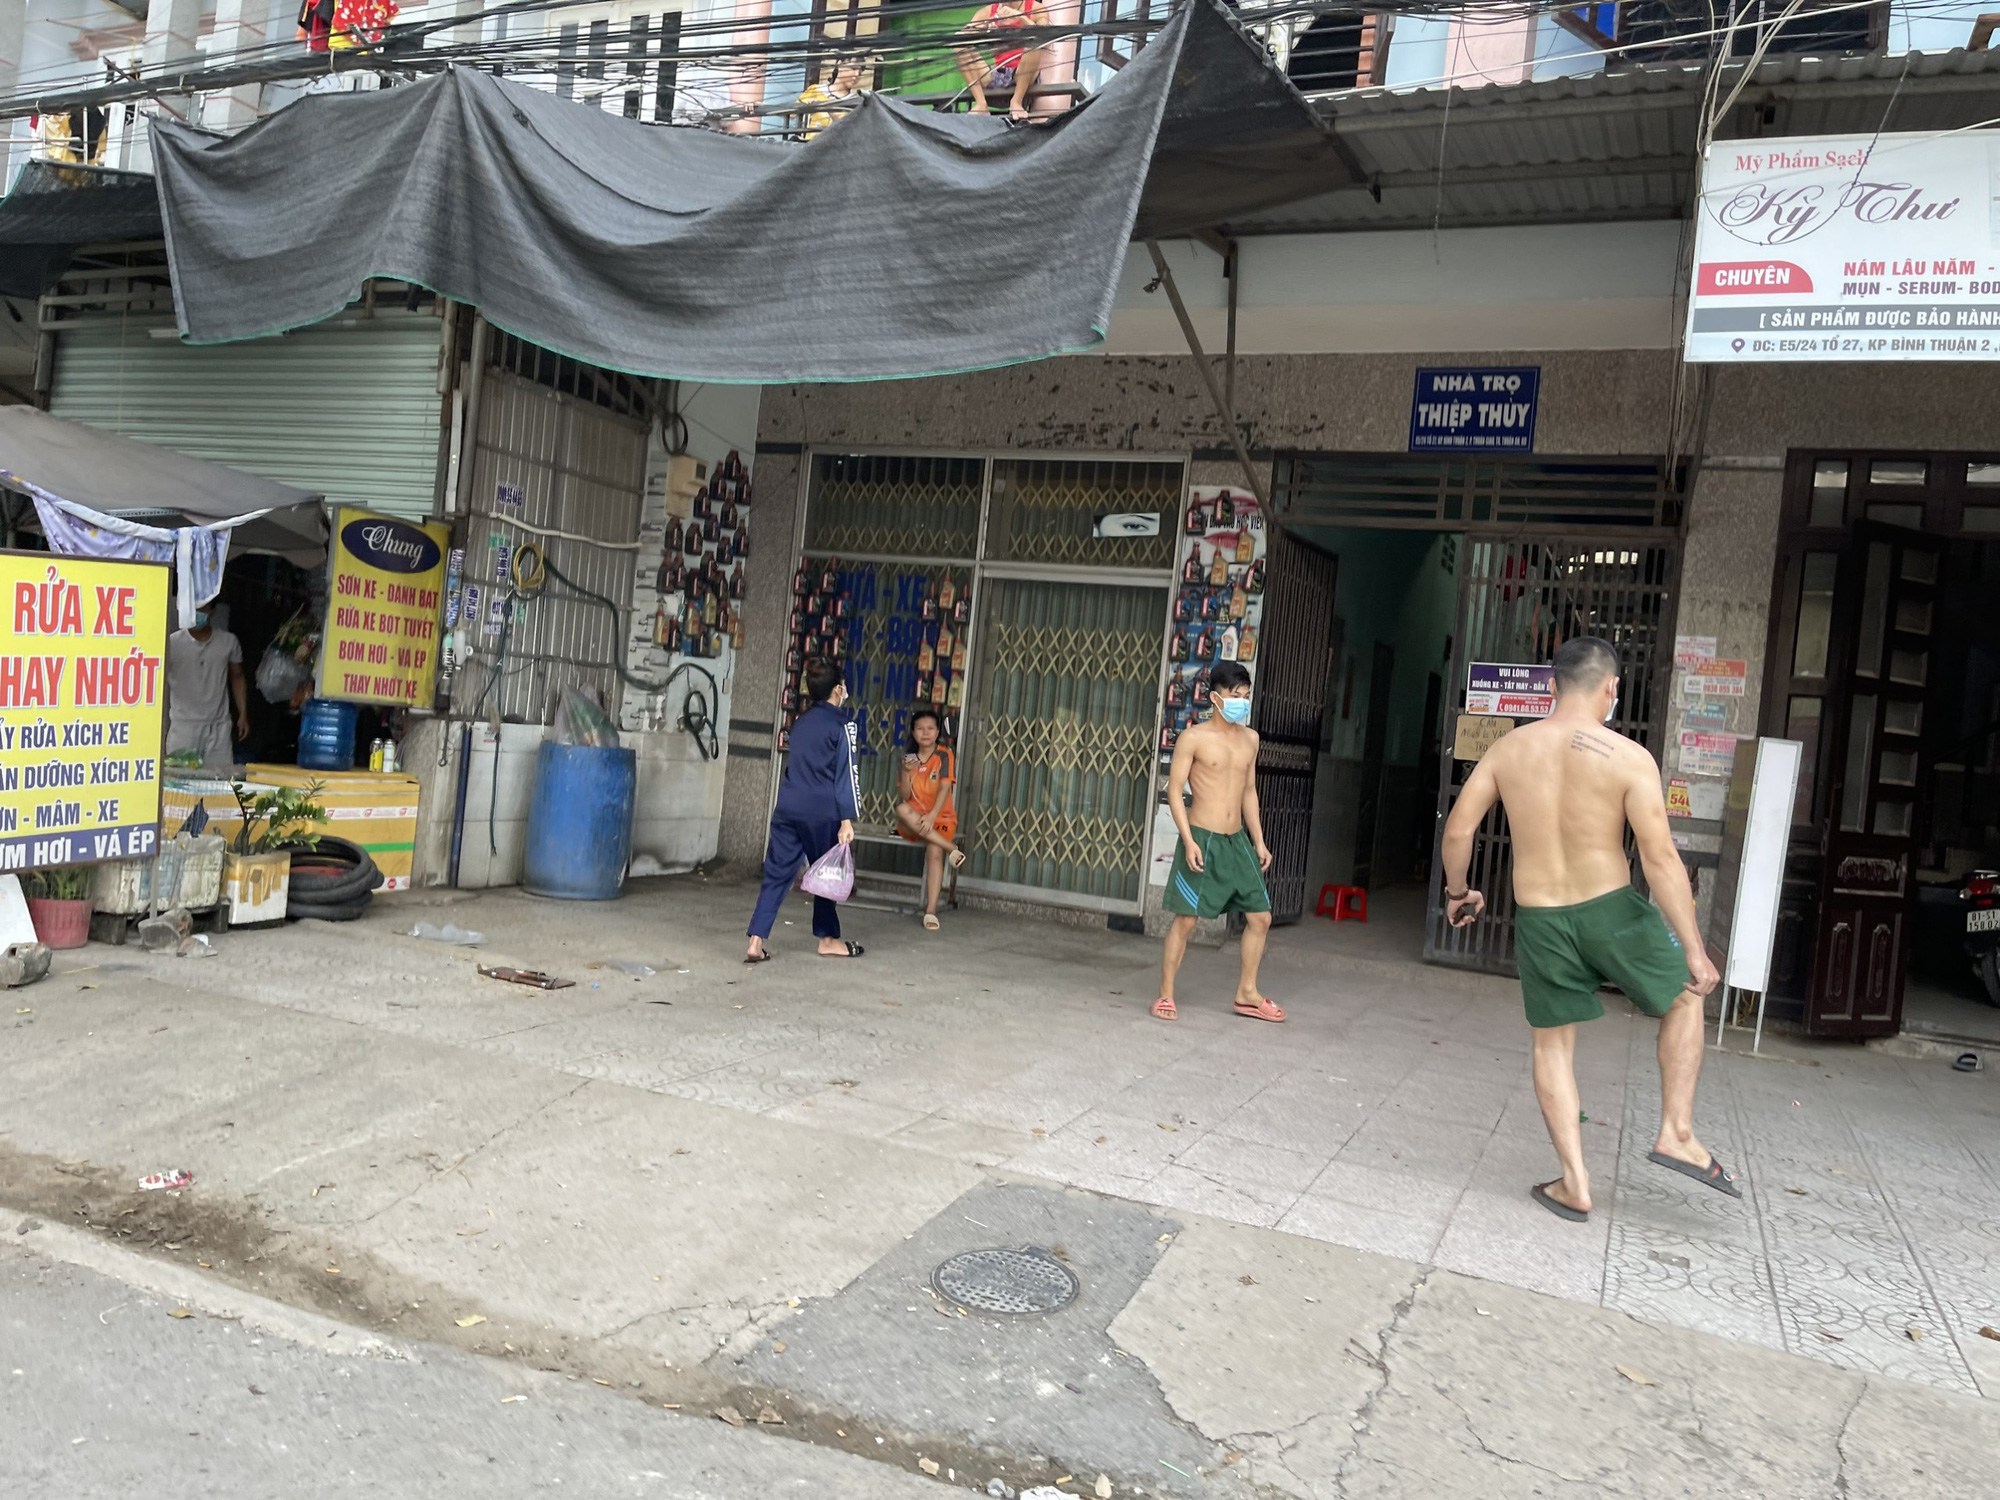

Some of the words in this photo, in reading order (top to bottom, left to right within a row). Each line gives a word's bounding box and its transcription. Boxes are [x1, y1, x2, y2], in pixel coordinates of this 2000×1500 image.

[1735, 154, 1763, 173] Mỹ
[1768, 149, 1820, 169] Phẩm
[1824, 149, 1869, 170] Sạch
[1838, 180, 1961, 224] Thư
[1714, 264, 1791, 287] CHUYÊN
[1844, 259, 1886, 276] NÁM
[1892, 258, 1926, 276] LÂU
[1932, 257, 1976, 275] NĂM
[1842, 281, 1881, 298] MỤN
[1771, 308, 1805, 326] SẢN
[1810, 307, 1860, 326] PHẨM
[1865, 309, 1911, 329] ĐƯỢC
[1916, 307, 1950, 326] BẢO
[1956, 308, 2000, 325] HÀNH
[1752, 340, 1775, 352] ĐC:
[1779, 339, 1817, 351] E5/24
[1822, 334, 1840, 351] TỔ
[1842, 339, 1863, 352] 27,
[1868, 339, 1887, 350] KP
[1891, 337, 1926, 350] BÌNH
[1930, 336, 1977, 354] THUẬN
[1981, 339, 1990, 351] 2
[1432, 372, 1475, 392] NHÀ
[1482, 375, 1521, 395] TRỌ
[1418, 398, 1472, 434] THIỆP
[362, 525, 425, 569] Chung
[338, 573, 361, 597] SƠN
[364, 579, 377, 599] XE
[896, 574, 926, 612] XE
[14, 566, 83, 636] RỬA
[93, 585, 136, 636] XE
[363, 611, 376, 632] XE
[379, 613, 401, 637] BỌT
[339, 638, 365, 662] BƠM
[368, 643, 387, 664] HƠI
[75, 646, 161, 706] NHỚT
[1492, 680, 1499, 689] XE
[1499, 667, 1511, 677] VUI
[344, 673, 371, 695] THAY
[373, 675, 402, 697] NHỚT
[405, 680, 417, 699] XE
[21, 717, 56, 749] RỬA
[62, 719, 101, 747] XÍCH
[108, 722, 129, 745] XE
[24, 759, 84, 789] DƯỠNG
[90, 756, 129, 784] XÍCH
[135, 759, 155, 782] XE
[35, 799, 80, 828] MÂM
[98, 799, 119, 822] XE
[34, 836, 72, 867] HƠI
[94, 829, 123, 859] VÁ
[132, 826, 155, 856] ÉP
